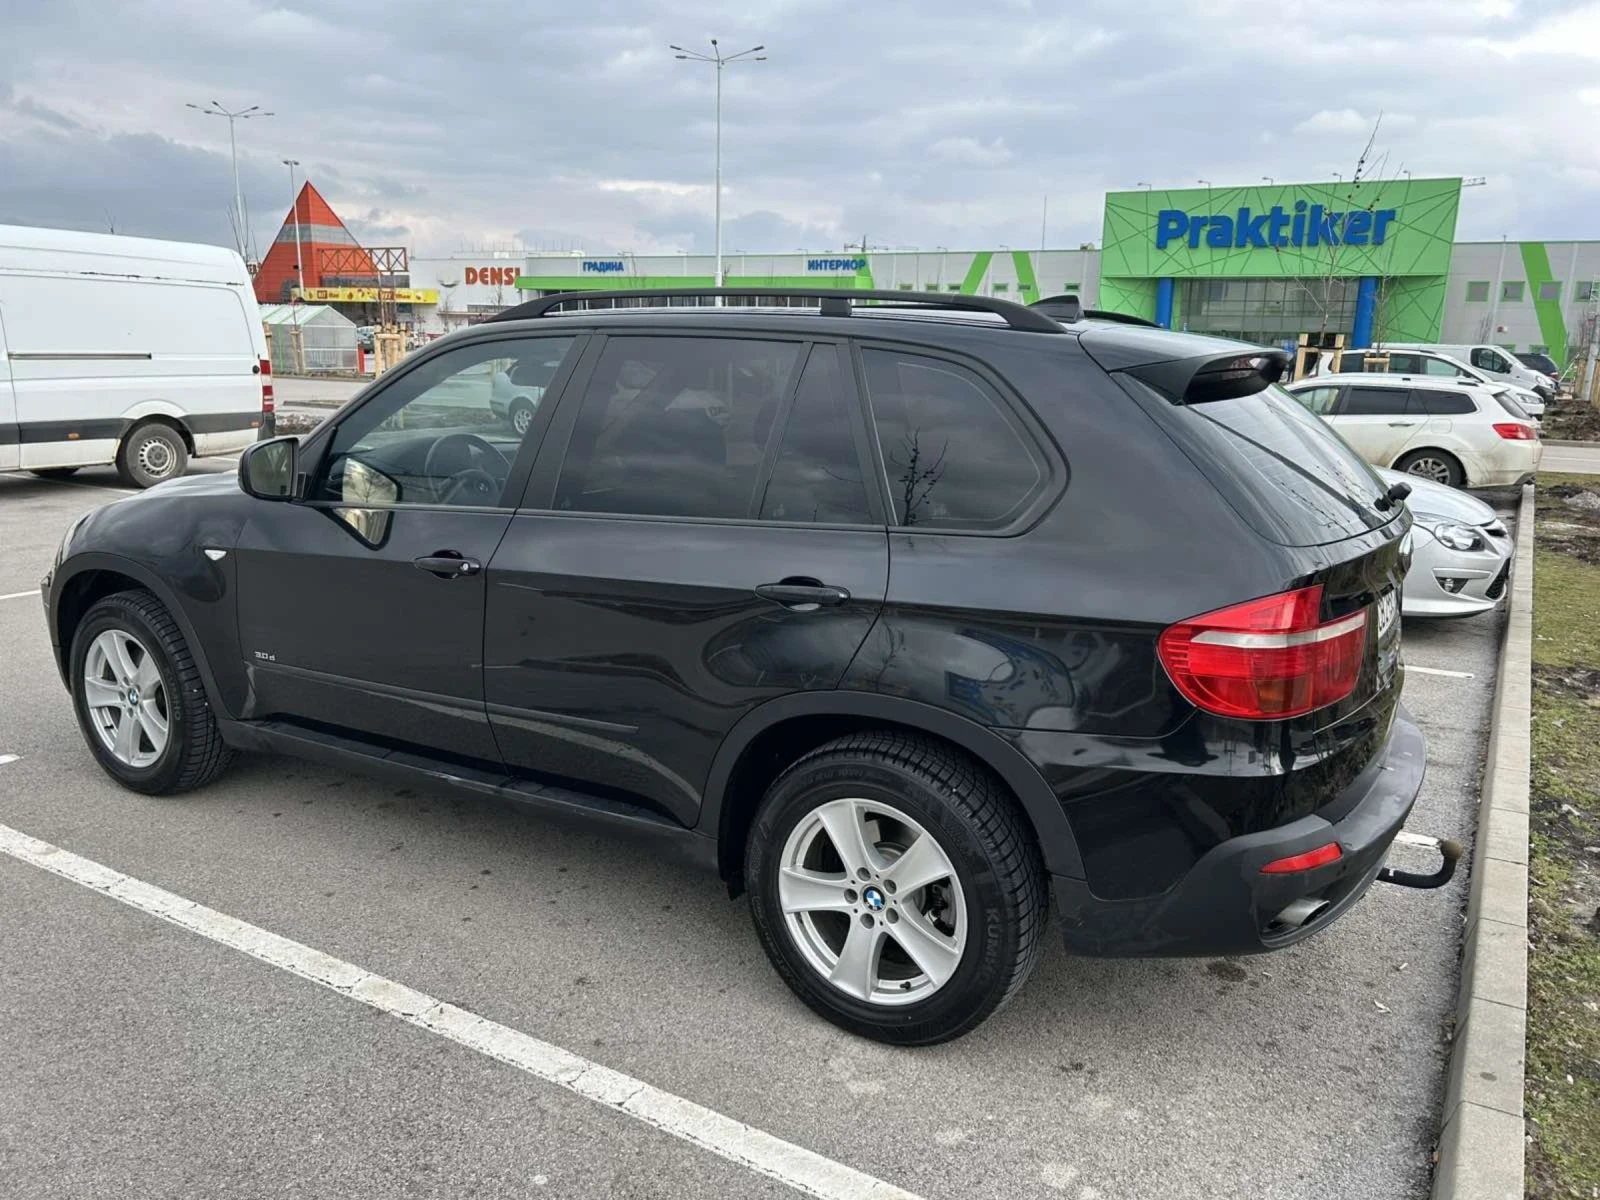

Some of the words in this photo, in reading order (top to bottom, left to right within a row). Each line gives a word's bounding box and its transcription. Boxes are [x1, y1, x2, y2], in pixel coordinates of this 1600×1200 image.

[1156, 200, 1396, 249] Praktiker
[582, 261, 624, 272] ГРАДИНА
[808, 259, 866, 271] ИНТЕРИОР
